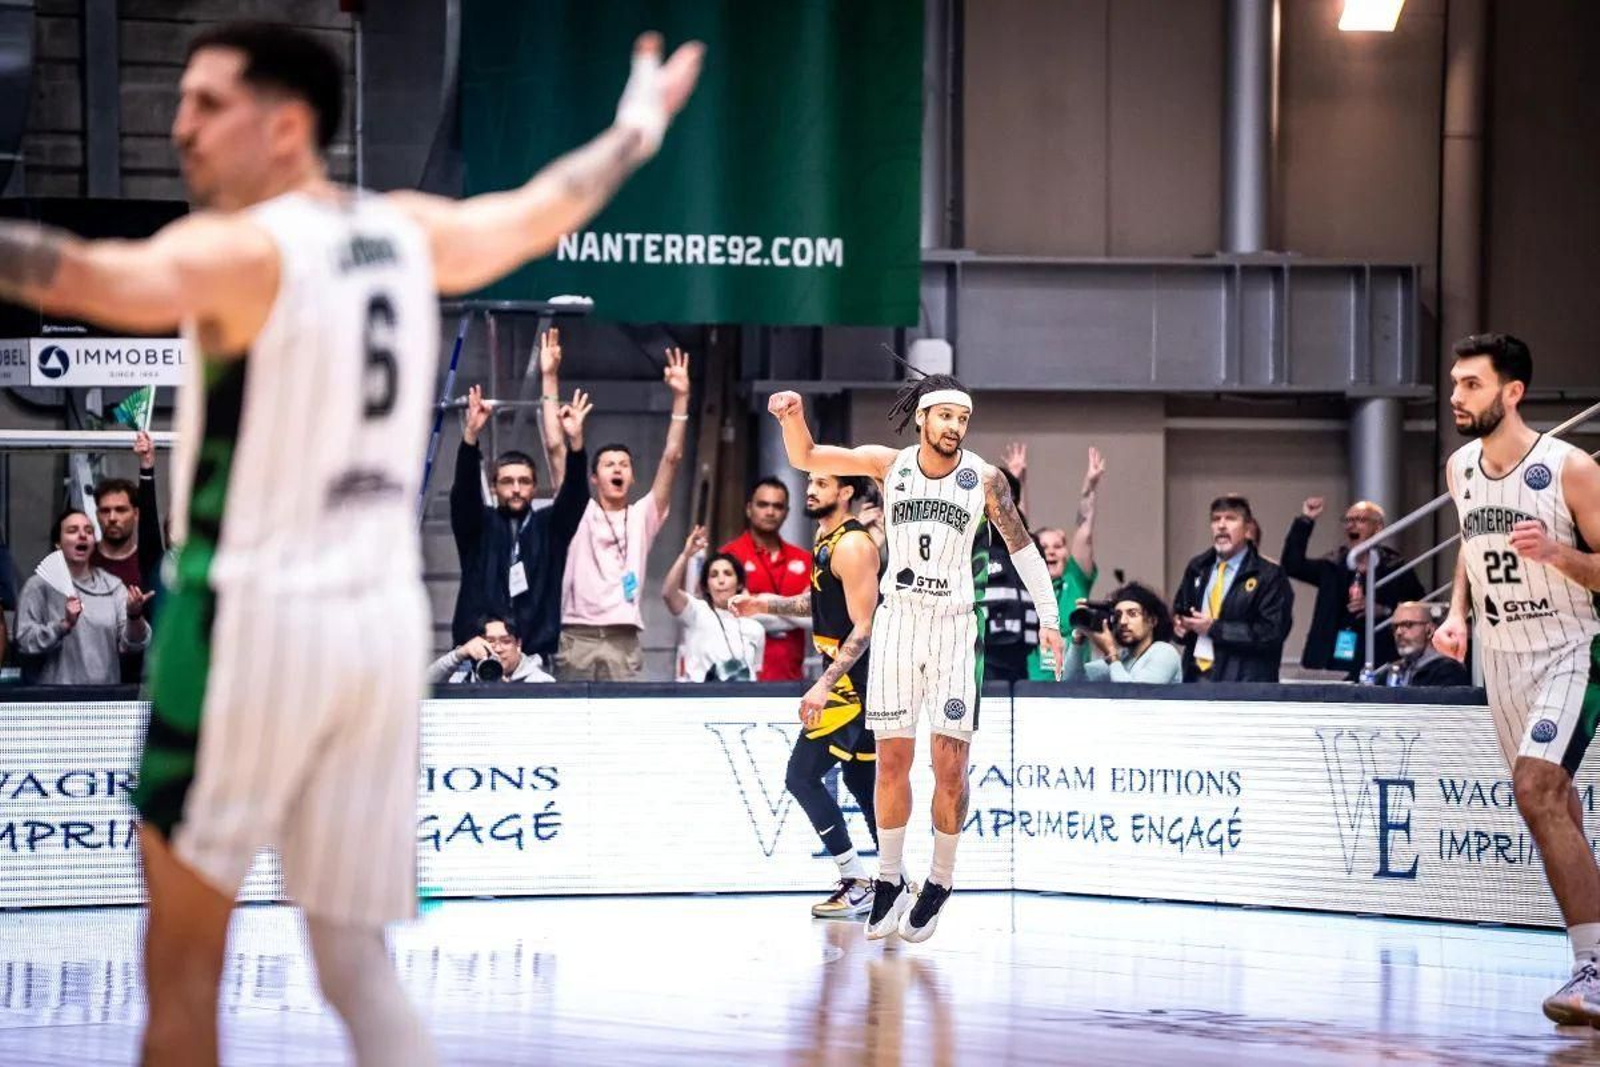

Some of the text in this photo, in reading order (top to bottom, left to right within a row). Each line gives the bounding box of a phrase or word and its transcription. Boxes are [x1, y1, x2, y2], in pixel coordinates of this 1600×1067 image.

[557, 231, 844, 268] NANTERRE92.COM
[75, 348, 188, 365] IMMOBEL
[361, 293, 398, 424] 6
[891, 498, 971, 535] NANTERRE92
[919, 534, 932, 561] 8
[916, 576, 949, 589] GTM
[1484, 551, 1522, 584] 22
[1503, 598, 1549, 613] GTM
[969, 764, 1242, 797] AGRAM EDITIONS
[1131, 806, 1243, 855] ENGAGÉ
